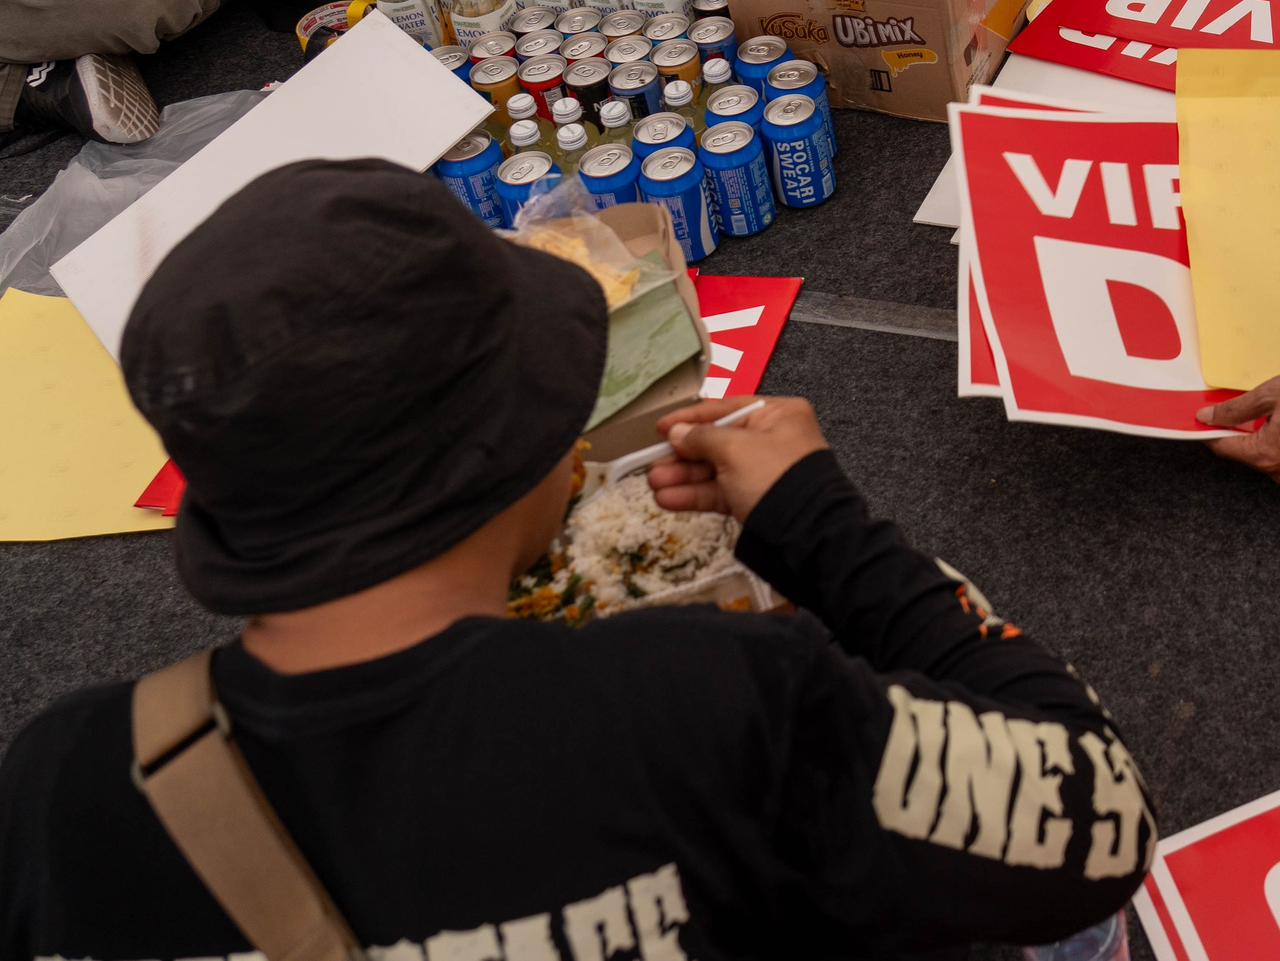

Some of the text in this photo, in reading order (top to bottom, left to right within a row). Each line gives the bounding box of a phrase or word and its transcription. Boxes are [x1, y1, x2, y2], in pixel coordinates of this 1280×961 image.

[391, 11, 424, 23] LEMON
[897, 51, 924, 59] Honey
[777, 142, 801, 199] SWEAT
[790, 140, 816, 204] POCARI
[1033, 235, 1202, 392] D
